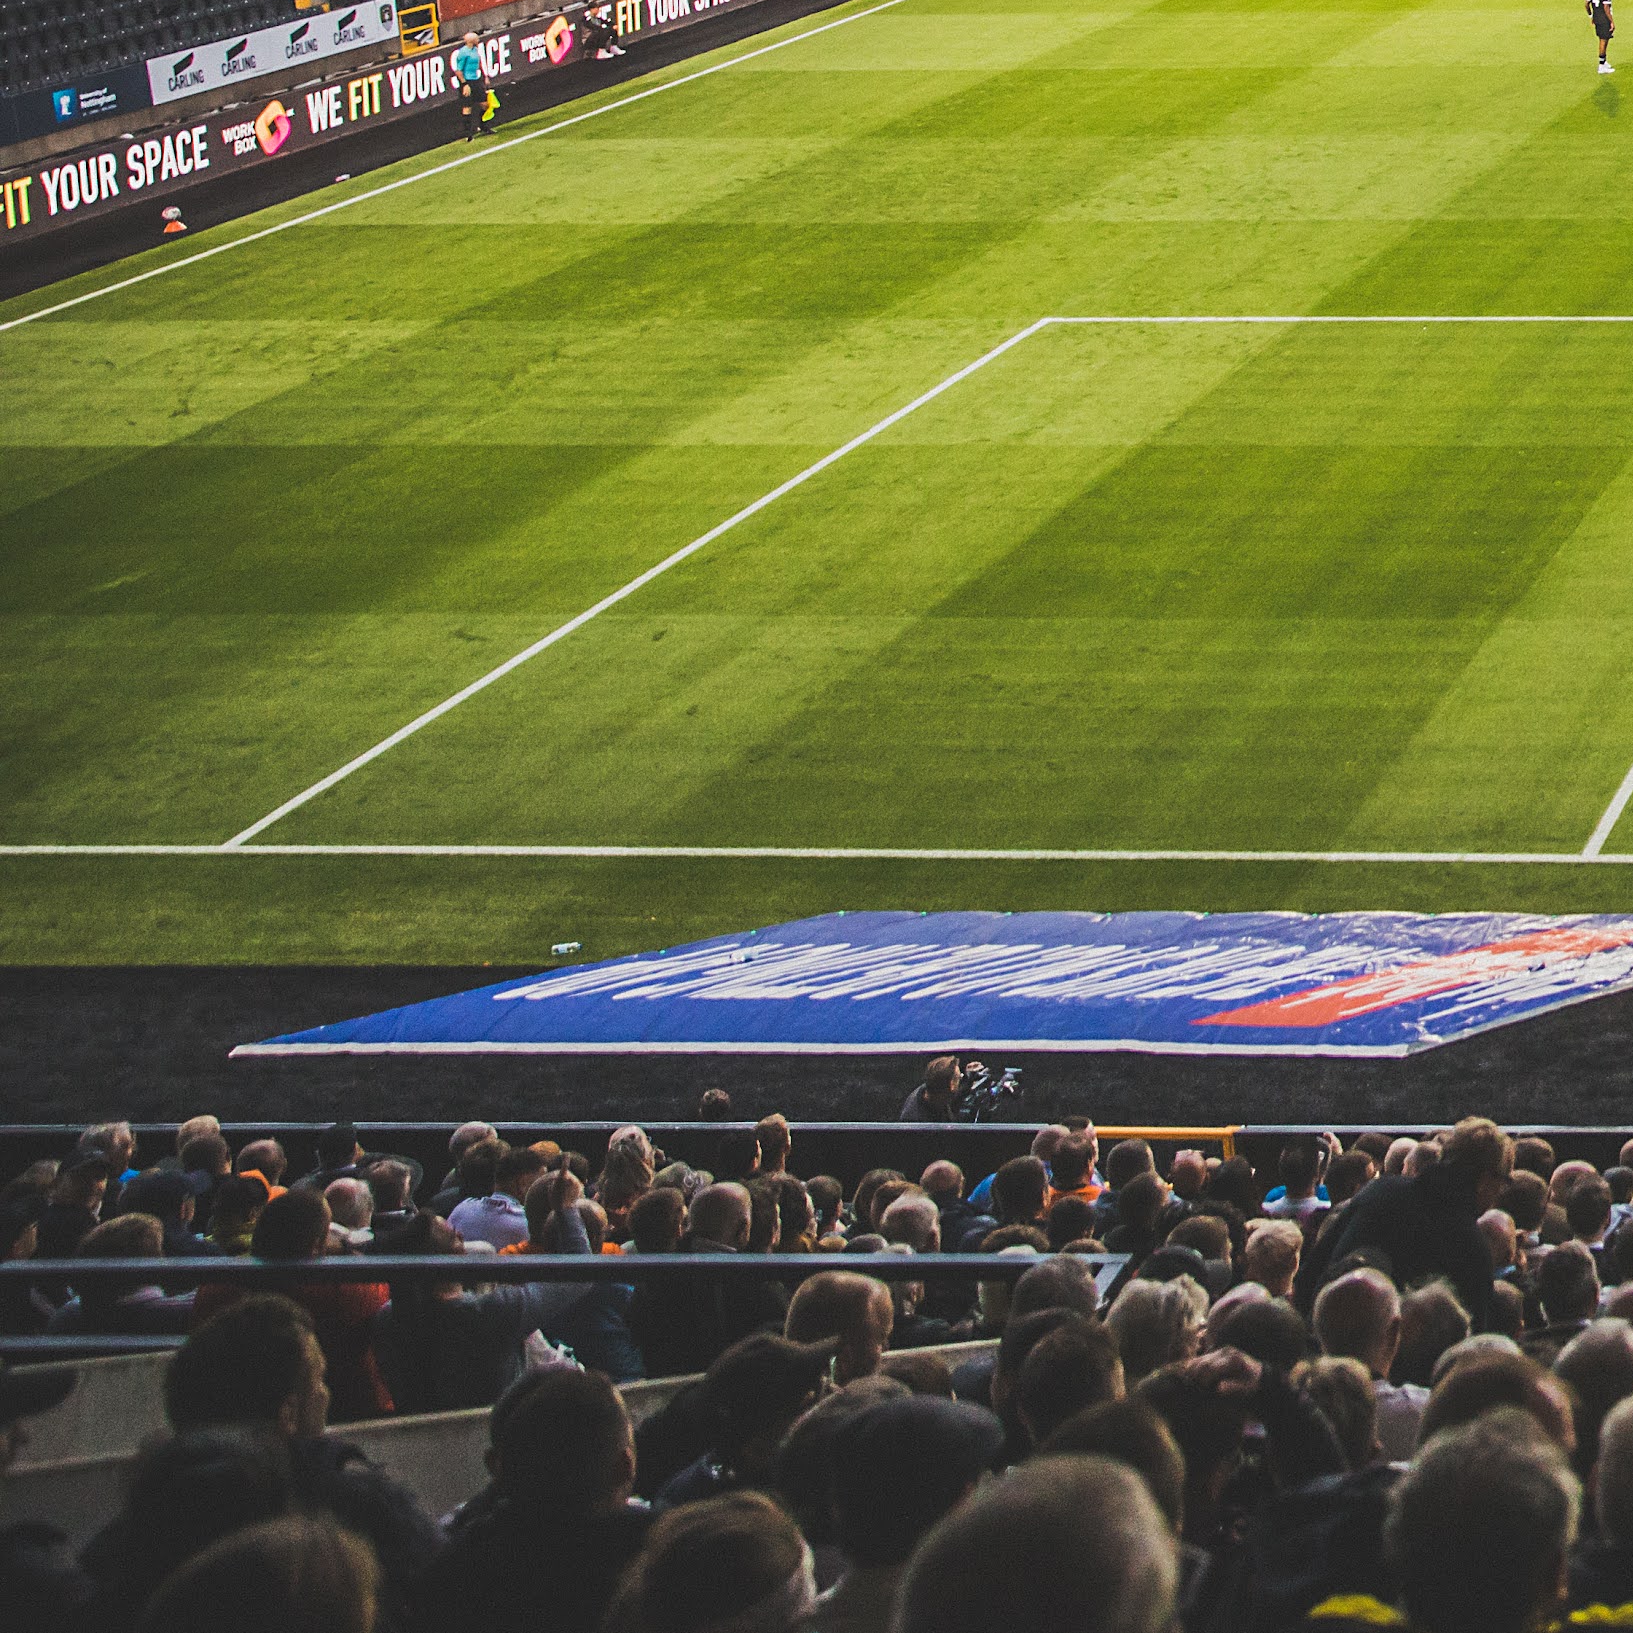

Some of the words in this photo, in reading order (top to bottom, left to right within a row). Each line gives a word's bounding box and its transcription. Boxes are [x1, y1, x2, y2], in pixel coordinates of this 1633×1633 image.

[333, 25, 366, 46] CARLING
[520, 34, 546, 53] WORK
[285, 38, 318, 60] CARLING
[528, 46, 548, 64] BOX
[221, 54, 256, 78] CARLING
[168, 68, 204, 92] CARLING
[306, 86, 344, 134] WE
[348, 72, 384, 122] FIT
[386, 56, 446, 108] YOUR
[222, 120, 256, 144] WORK
[234, 137, 258, 157] BOX
[40, 152, 120, 216] YOUR
[126, 124, 210, 190] SPACE
